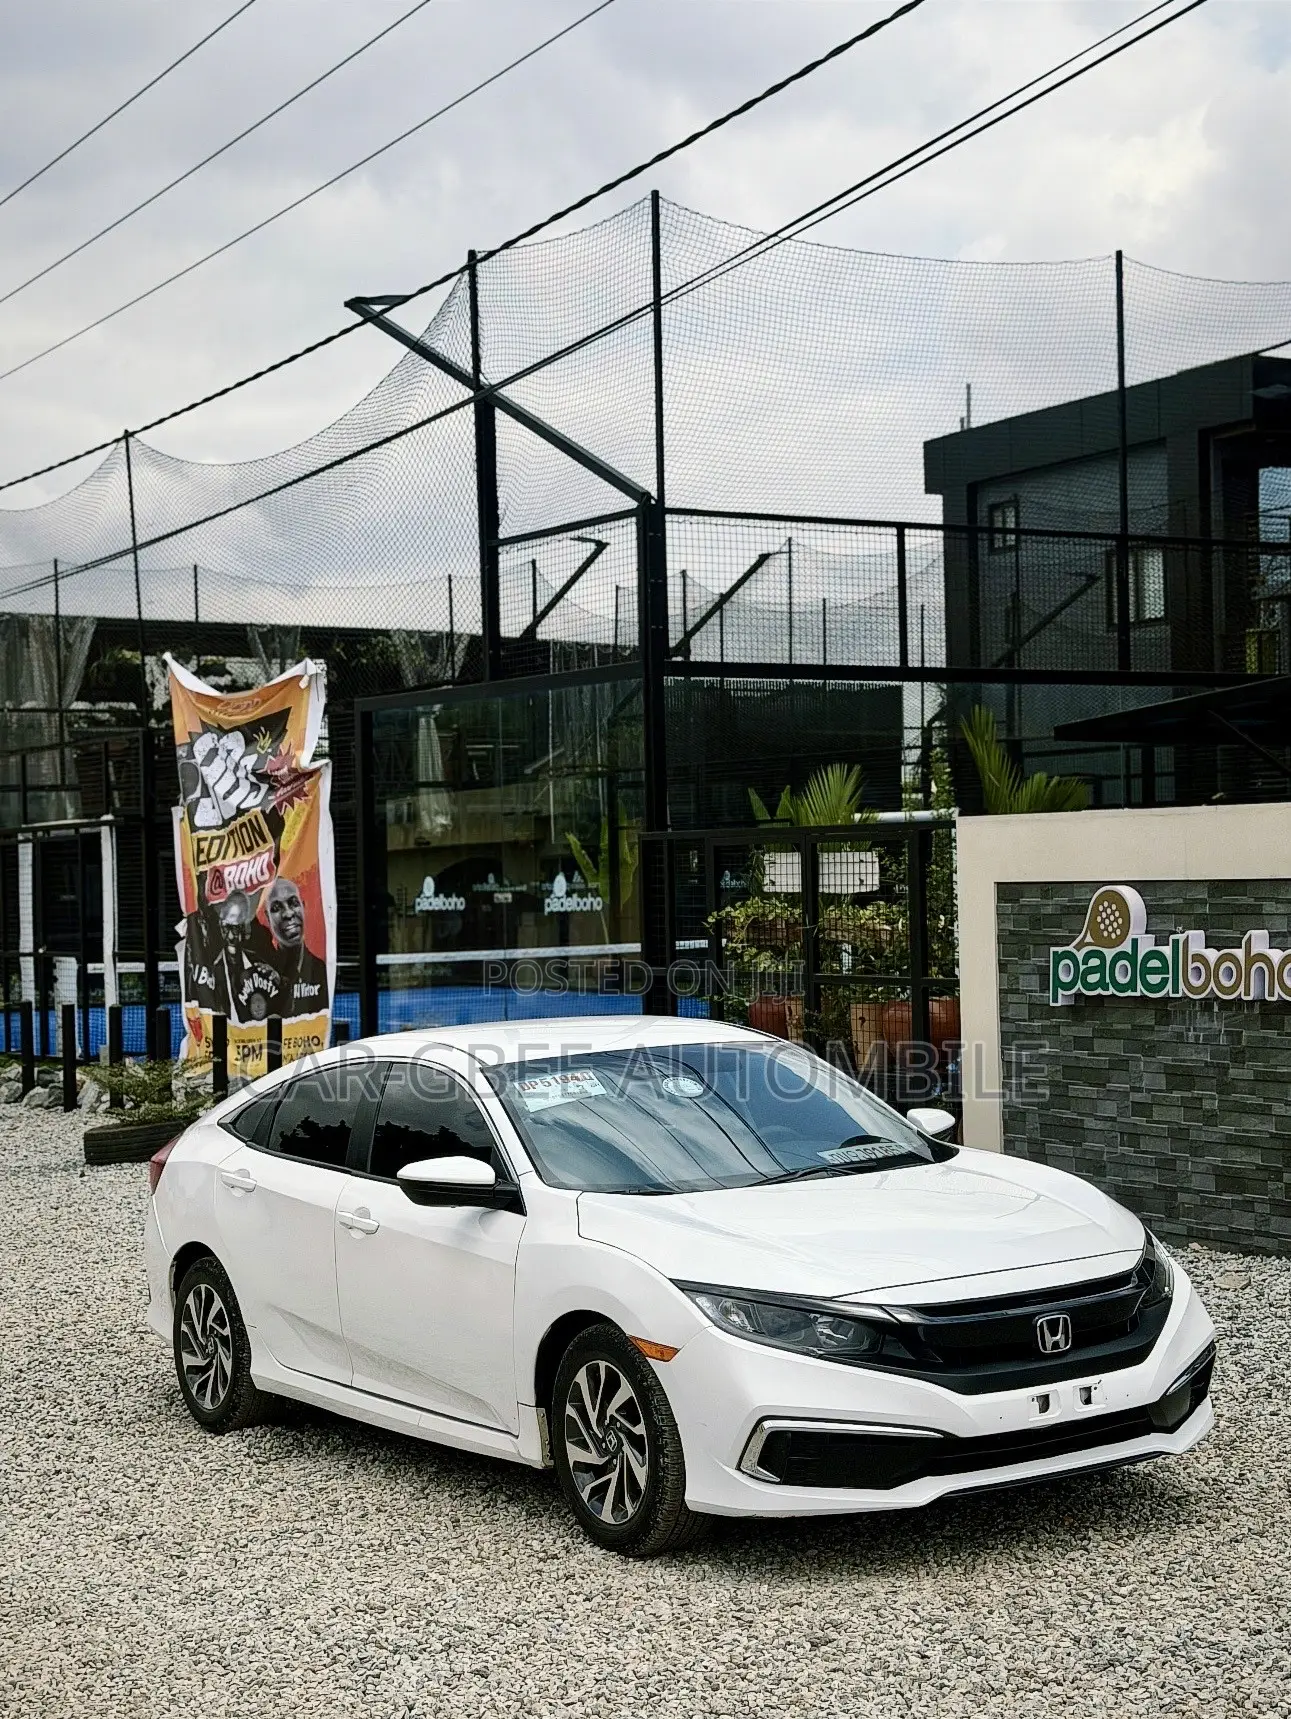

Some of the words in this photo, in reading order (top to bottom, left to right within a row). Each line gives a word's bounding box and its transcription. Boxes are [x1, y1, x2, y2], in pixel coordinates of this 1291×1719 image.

[196, 815, 268, 866] EDITION
[210, 852, 270, 895] @BOHO
[415, 893, 466, 913] padelboho
[544, 893, 603, 915] padelboho
